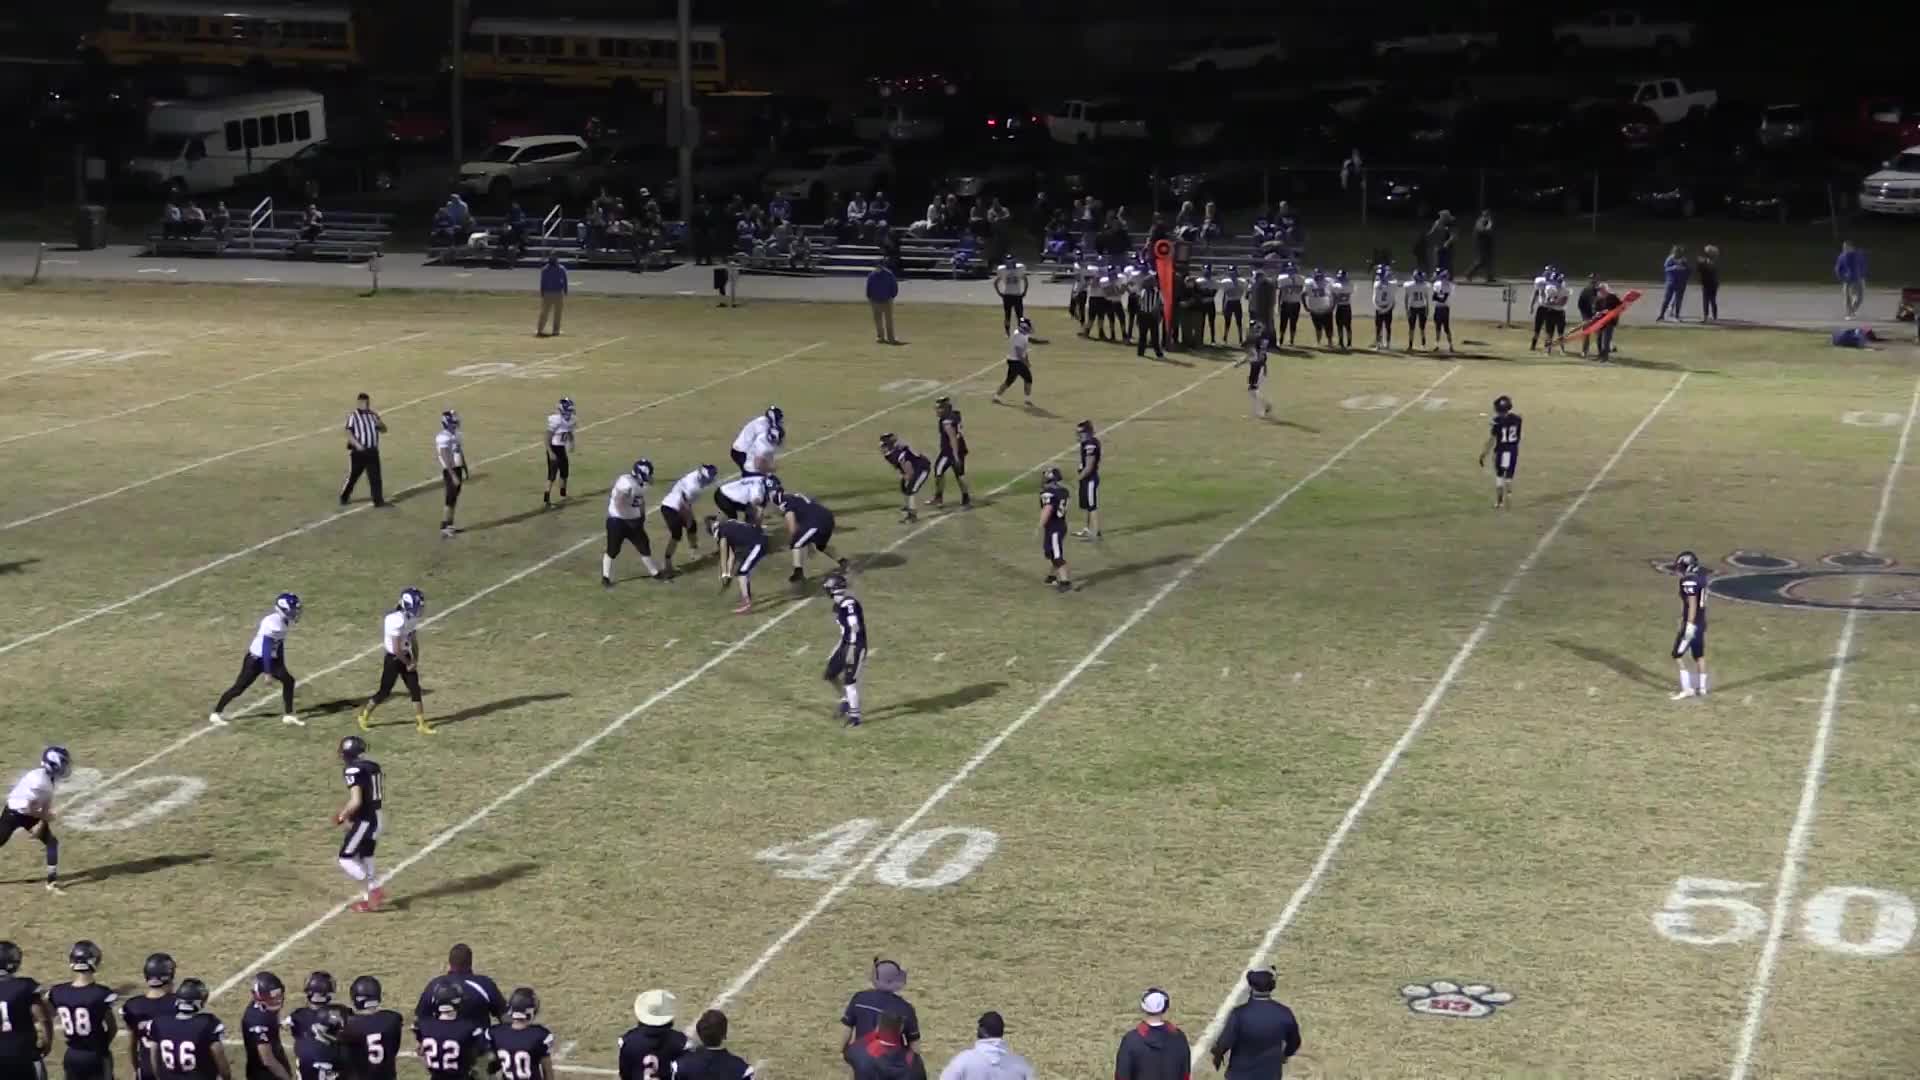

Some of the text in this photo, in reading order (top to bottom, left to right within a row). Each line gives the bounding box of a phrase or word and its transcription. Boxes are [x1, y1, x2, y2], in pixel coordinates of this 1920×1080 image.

[1501, 425, 1518, 443] 12
[753, 816, 999, 888] 40
[1652, 875, 1919, 957] 50
[56, 1006, 91, 1036] 88
[160, 1039, 196, 1071] 66
[366, 1033, 385, 1064] 5
[422, 1037, 461, 1070] 22
[497, 1049, 532, 1080] 20
